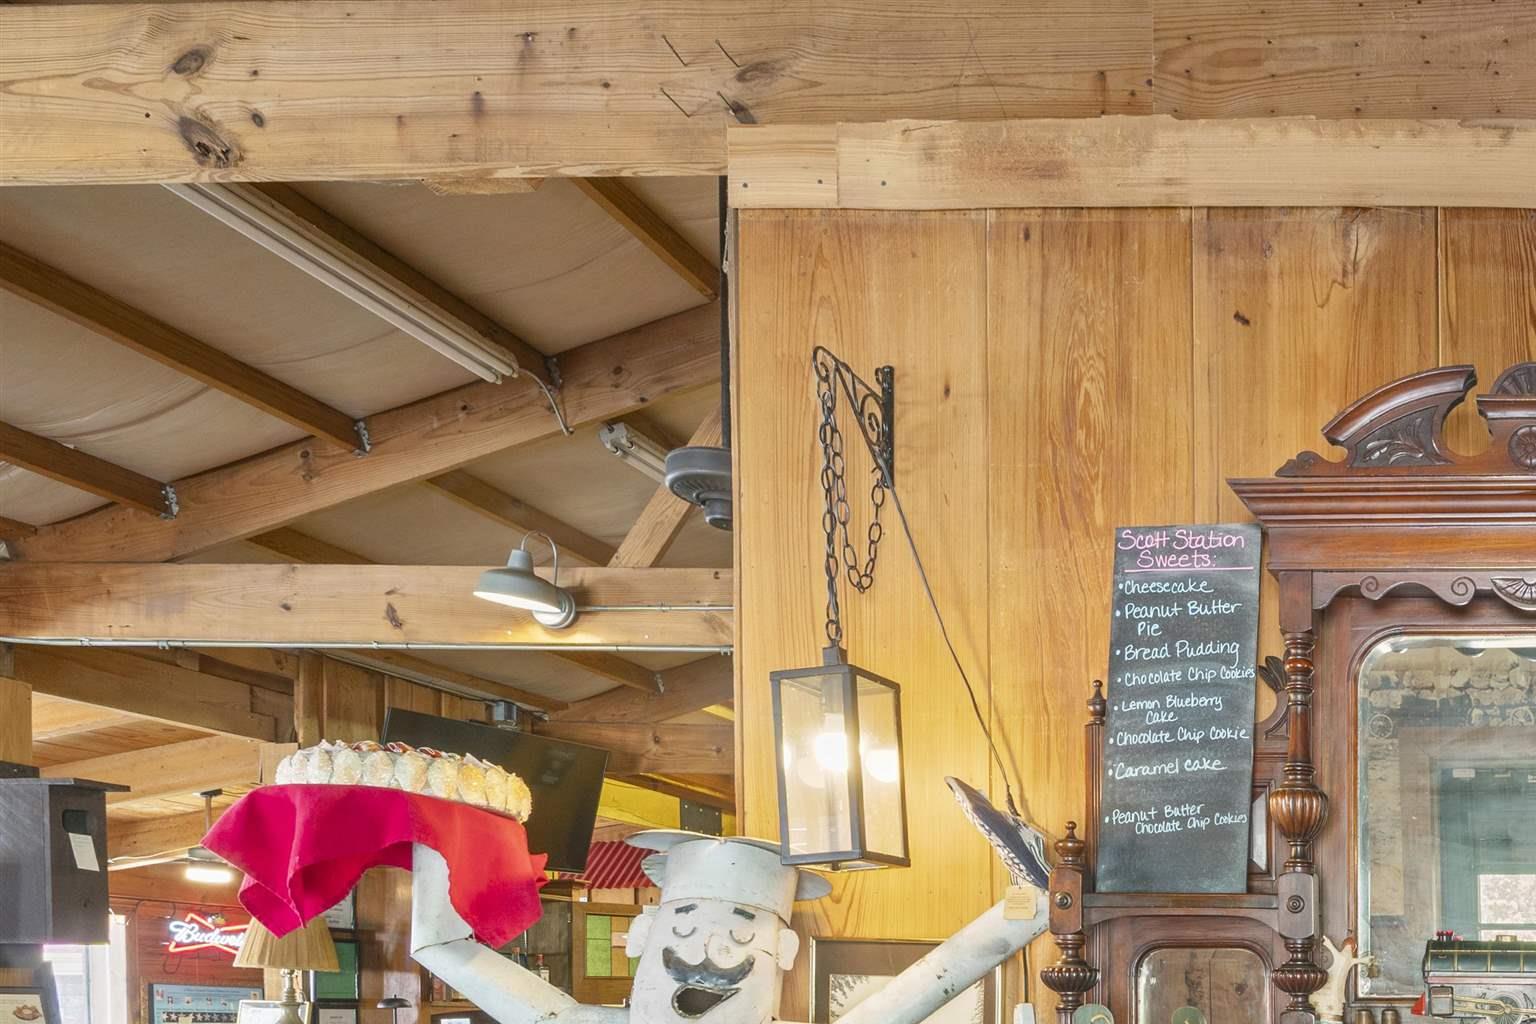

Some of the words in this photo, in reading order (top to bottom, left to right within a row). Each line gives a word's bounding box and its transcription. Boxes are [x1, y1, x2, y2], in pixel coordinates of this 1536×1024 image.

[1117, 529, 1170, 550] Scott
[1173, 529, 1245, 549] Station
[1136, 549, 1217, 568] Sweets:
[1124, 578, 1214, 595] Cheesecake
[1124, 602, 1182, 619] Peanut
[1187, 599, 1243, 616] Butter
[1137, 621, 1162, 636] Pie
[1124, 643, 1171, 661] Bread
[1175, 640, 1240, 669] Pudding
[1124, 670, 1182, 687] Chocolate
[1187, 666, 1217, 683] Chip
[1220, 664, 1256, 679] Cookies
[1121, 699, 1160, 712] Lemon
[1166, 692, 1223, 711] Blueberry
[1116, 730, 1175, 746] Chocolate
[1177, 726, 1205, 744] Chip
[1209, 726, 1250, 740] Cookie
[1115, 758, 1179, 779] Caramel
[1112, 806, 1158, 825] Peanut
[1135, 820, 1183, 834] Chocolate
